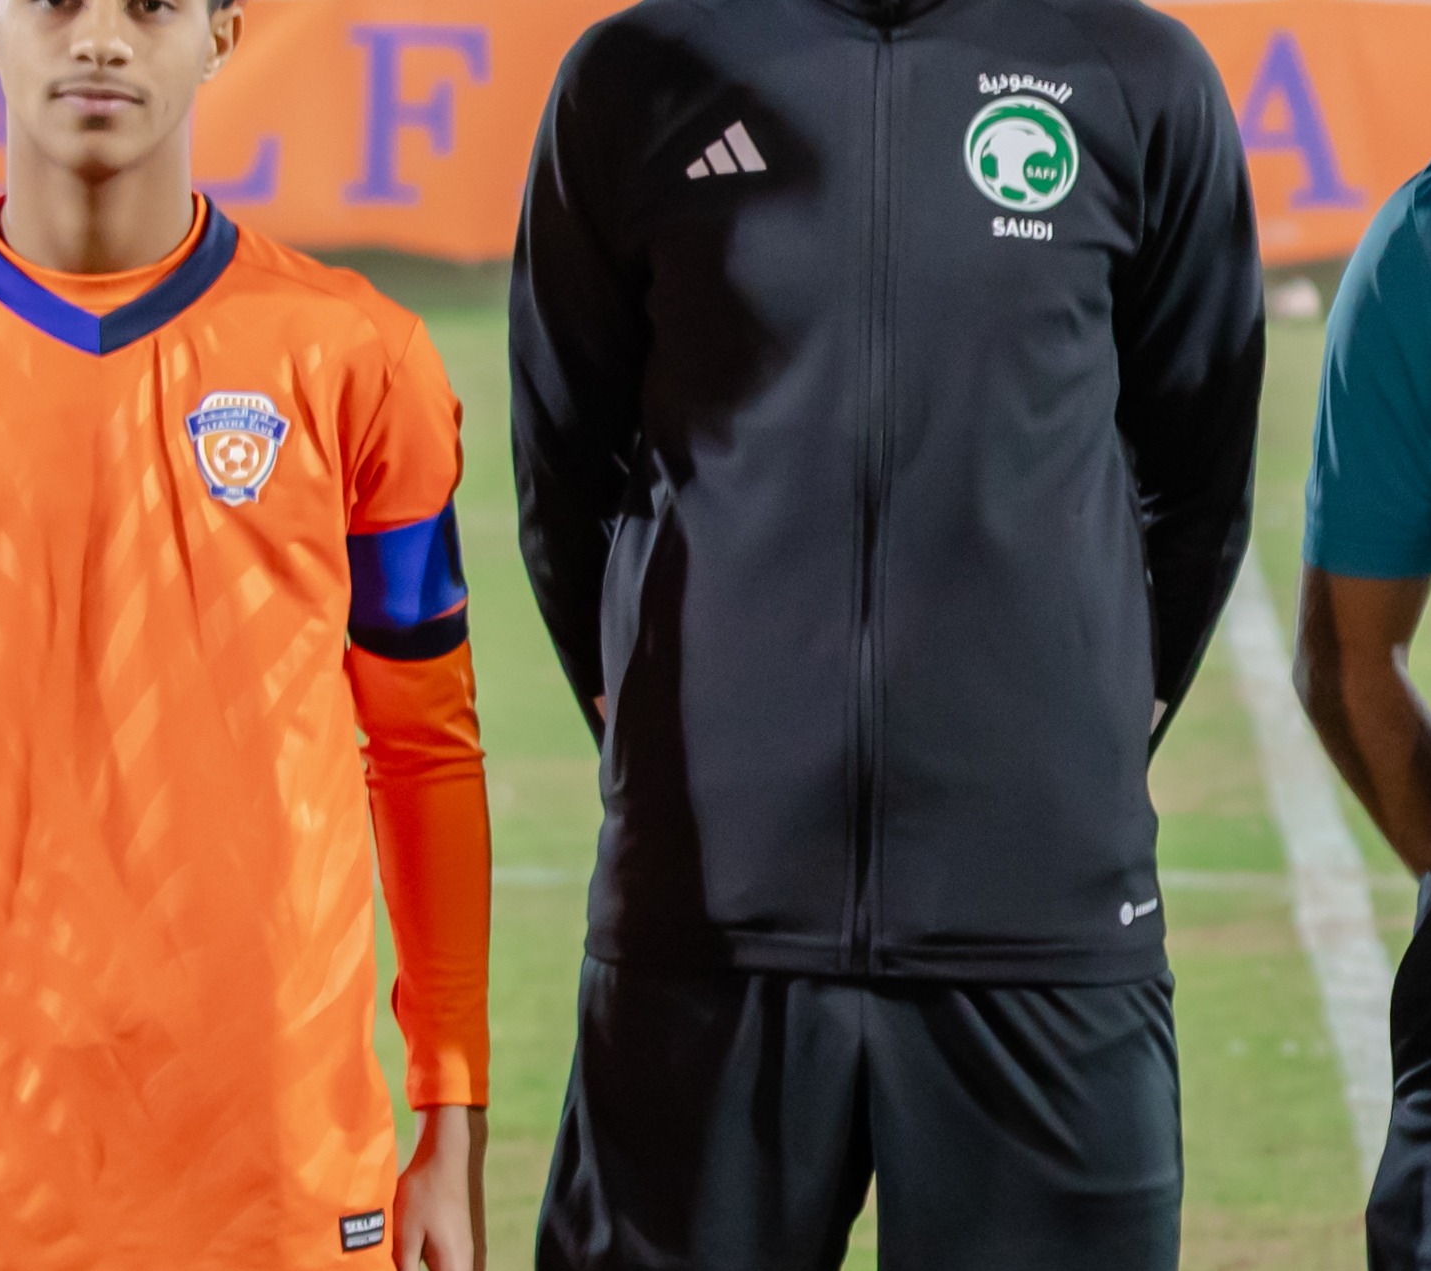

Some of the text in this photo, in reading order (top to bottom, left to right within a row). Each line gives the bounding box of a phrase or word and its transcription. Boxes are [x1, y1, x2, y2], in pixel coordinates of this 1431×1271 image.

[978, 73, 1073, 105] السعودية
[1025, 165, 1058, 182] SAFF
[992, 216, 1054, 242] SAUDI
